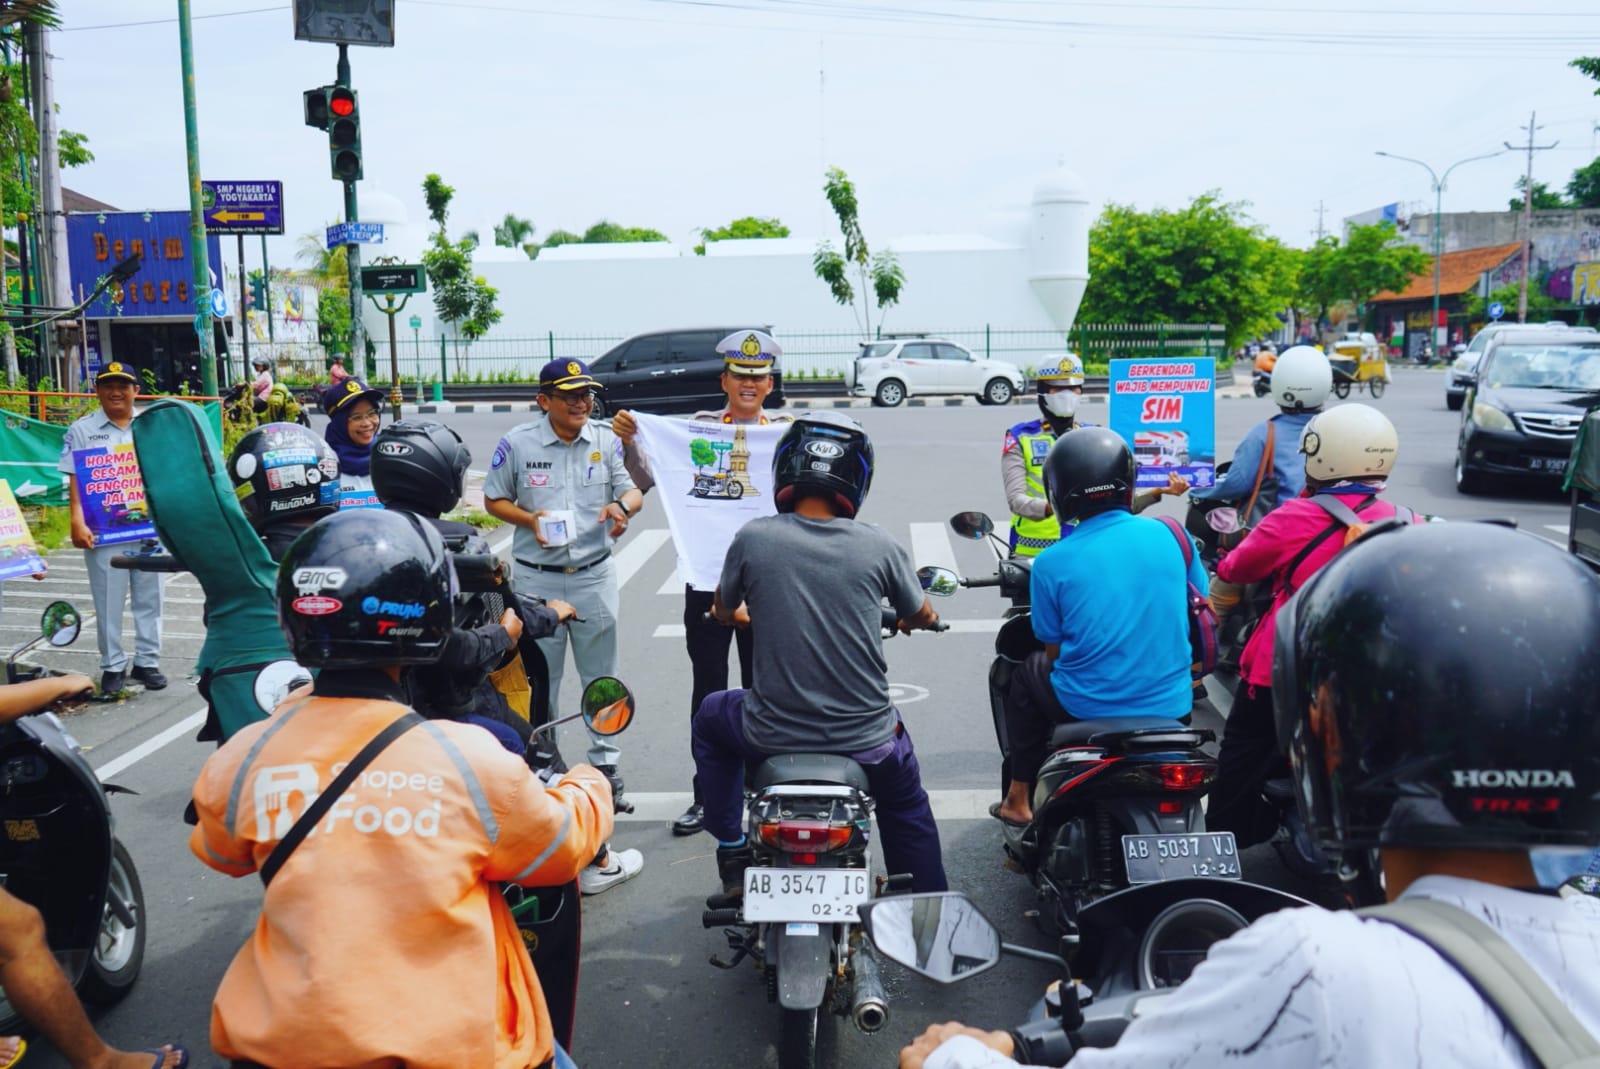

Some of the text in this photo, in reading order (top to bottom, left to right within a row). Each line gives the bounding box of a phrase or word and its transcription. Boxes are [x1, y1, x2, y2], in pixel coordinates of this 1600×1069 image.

[217, 184, 276, 193] SMP NEGERI 16
[220, 193, 274, 202] YOGYAKARTA
[328, 223, 380, 235] BELOK KIRI
[329, 231, 379, 242] JALAN TERU
[1129, 364, 1195, 377] BERKENDARA
[1116, 380, 1210, 393] WAJIB MEMPUNYAI
[1142, 398, 1182, 421] SIM
[86, 451, 135, 467] HORMA
[1084, 484, 1116, 494] HONDA
[102, 491, 145, 506] JALAN
[298, 571, 340, 585] BMC
[1452, 769, 1576, 788] HONDA
[325, 793, 442, 837] Food
[1128, 836, 1234, 858] AB 5037 VJ
[748, 874, 865, 895] AB 3547 IG
